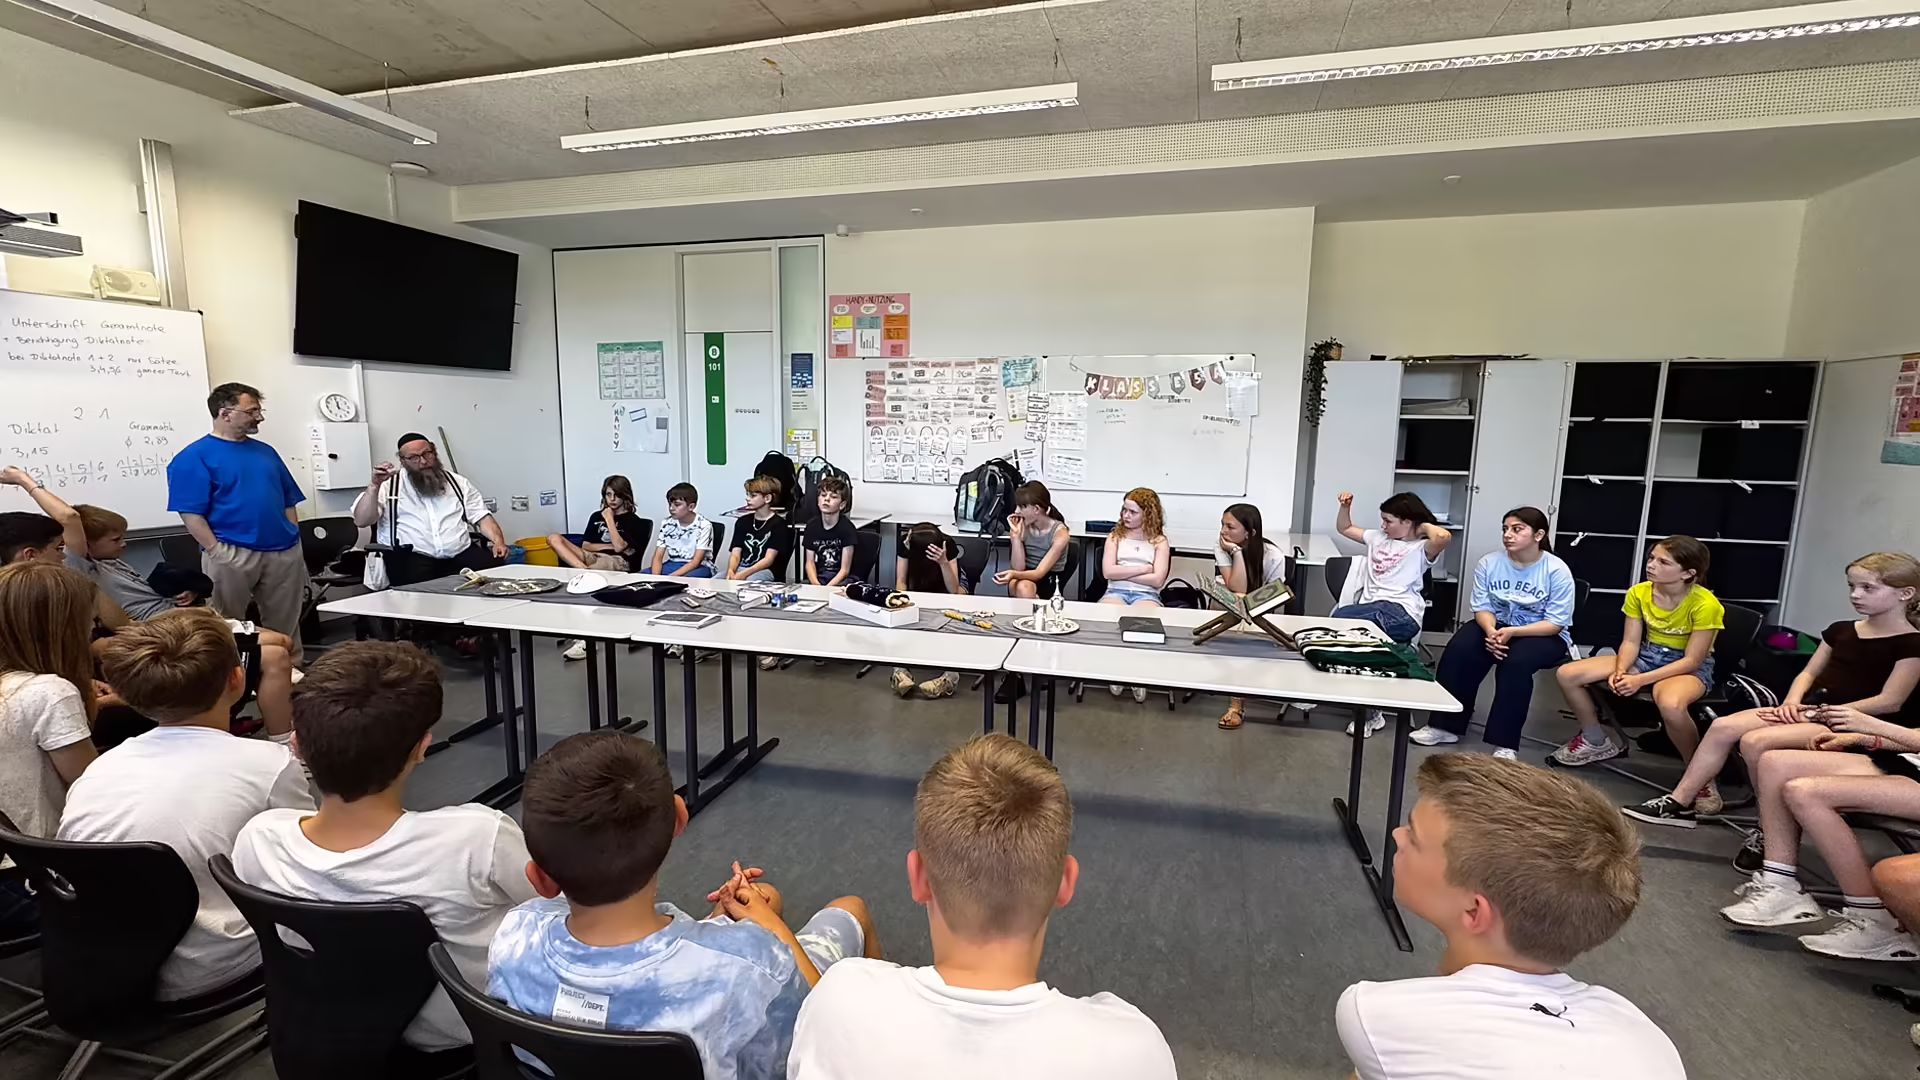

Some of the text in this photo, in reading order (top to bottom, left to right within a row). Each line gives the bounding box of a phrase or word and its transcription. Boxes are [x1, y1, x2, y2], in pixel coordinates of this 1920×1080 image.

[11, 317, 86, 329] Unterschrift
[16, 335, 79, 349] Berichtigung
[8, 351, 25, 361] bei
[711, 348, 717, 356] B
[708, 362, 721, 371] 101
[73, 406, 84, 421] 2
[7, 421, 60, 435] Diktat
[11, 446, 49, 459] 3,15
